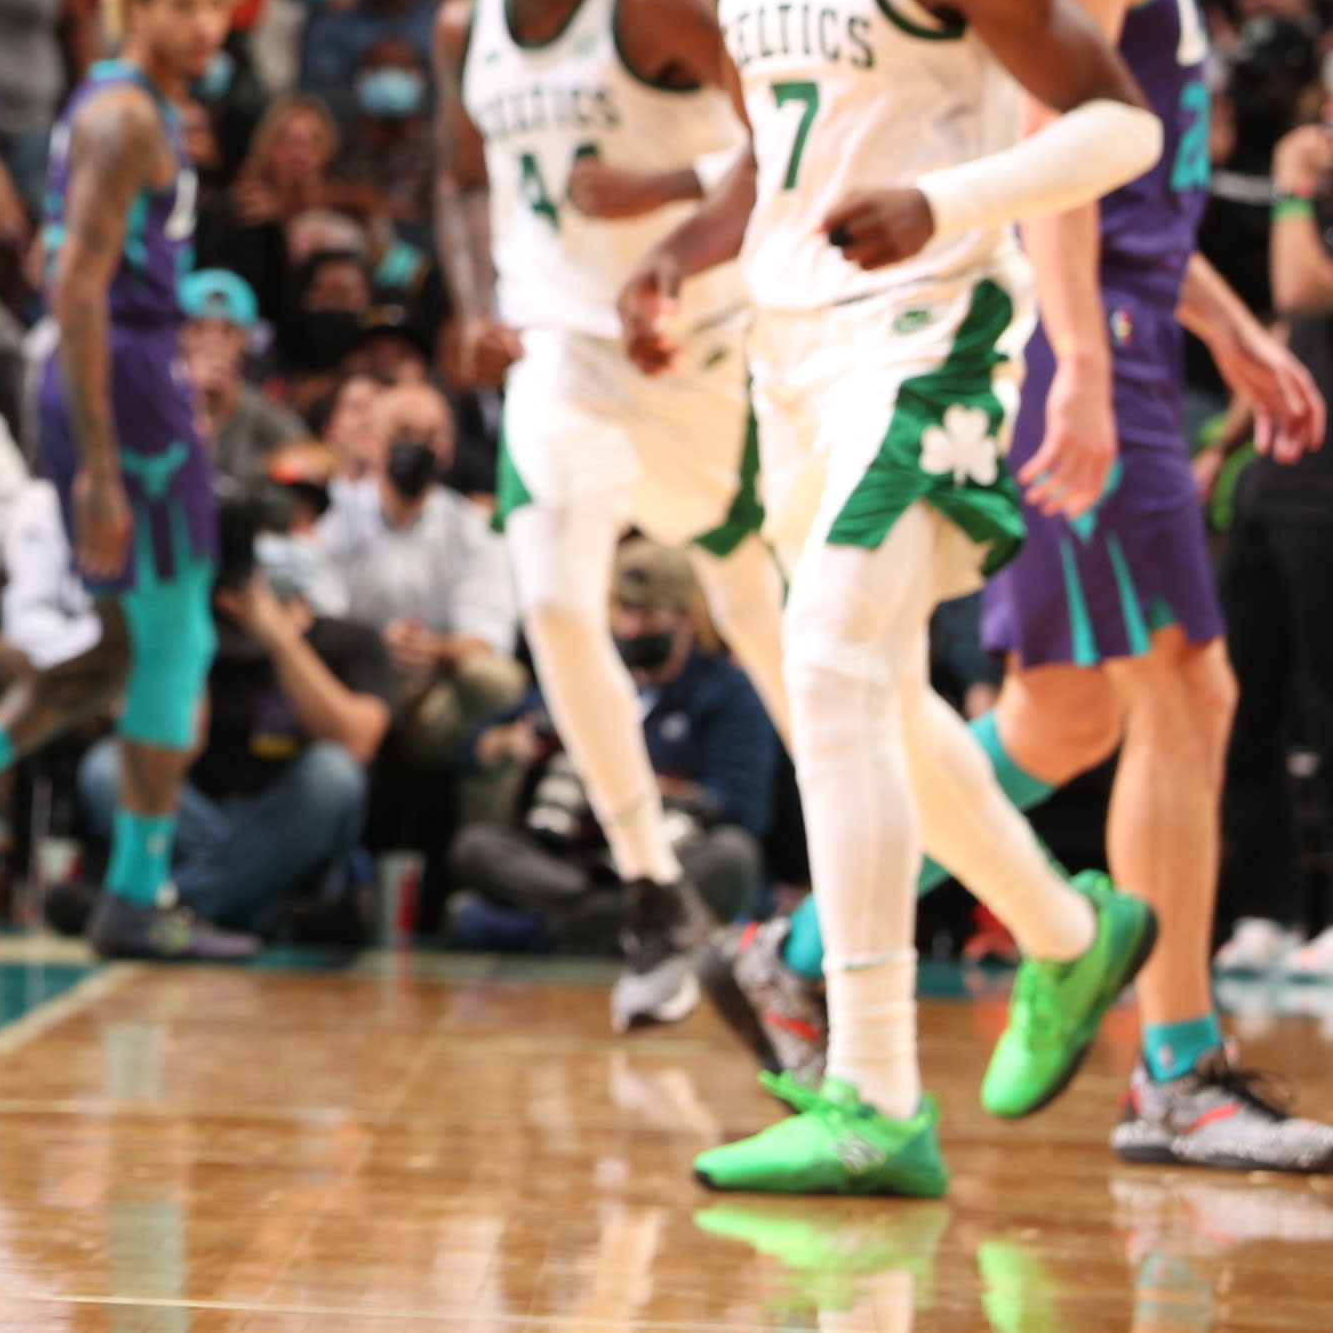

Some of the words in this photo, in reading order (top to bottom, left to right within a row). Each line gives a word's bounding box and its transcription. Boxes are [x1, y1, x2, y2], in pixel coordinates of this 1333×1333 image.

[722, 2, 874, 70] ELTICS
[770, 82, 820, 190] 7
[518, 143, 601, 233] 4
